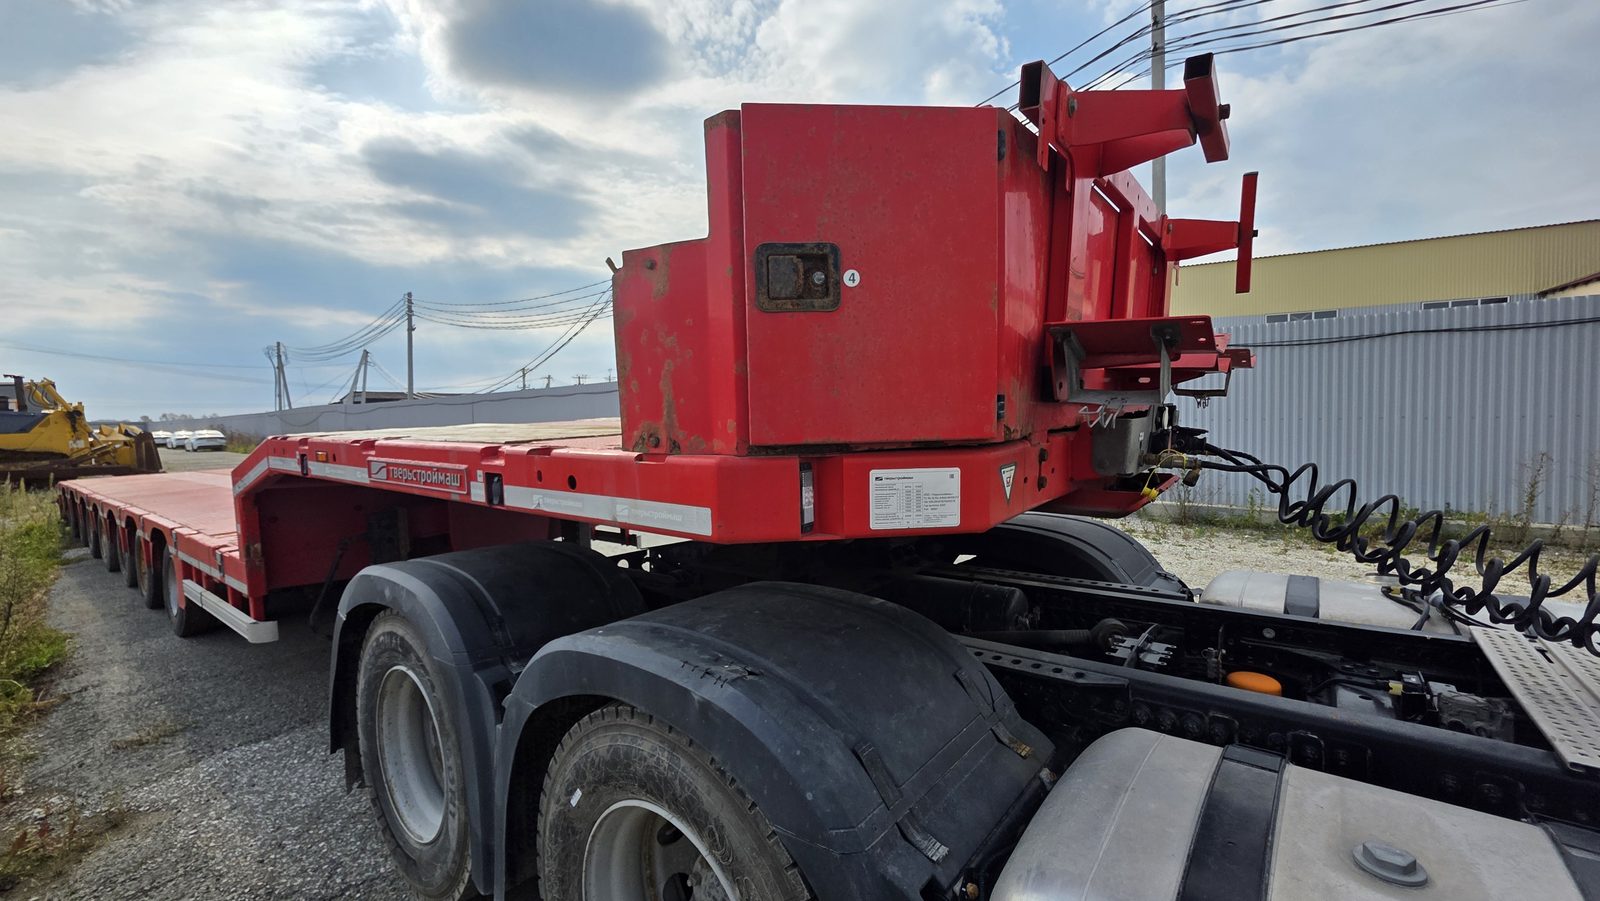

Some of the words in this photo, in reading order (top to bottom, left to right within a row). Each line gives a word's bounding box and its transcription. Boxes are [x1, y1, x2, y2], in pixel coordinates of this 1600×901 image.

[848, 272, 856, 284] 4
[389, 466, 460, 486] тверьстроймаш
[631, 508, 683, 522] рьстроймаш
